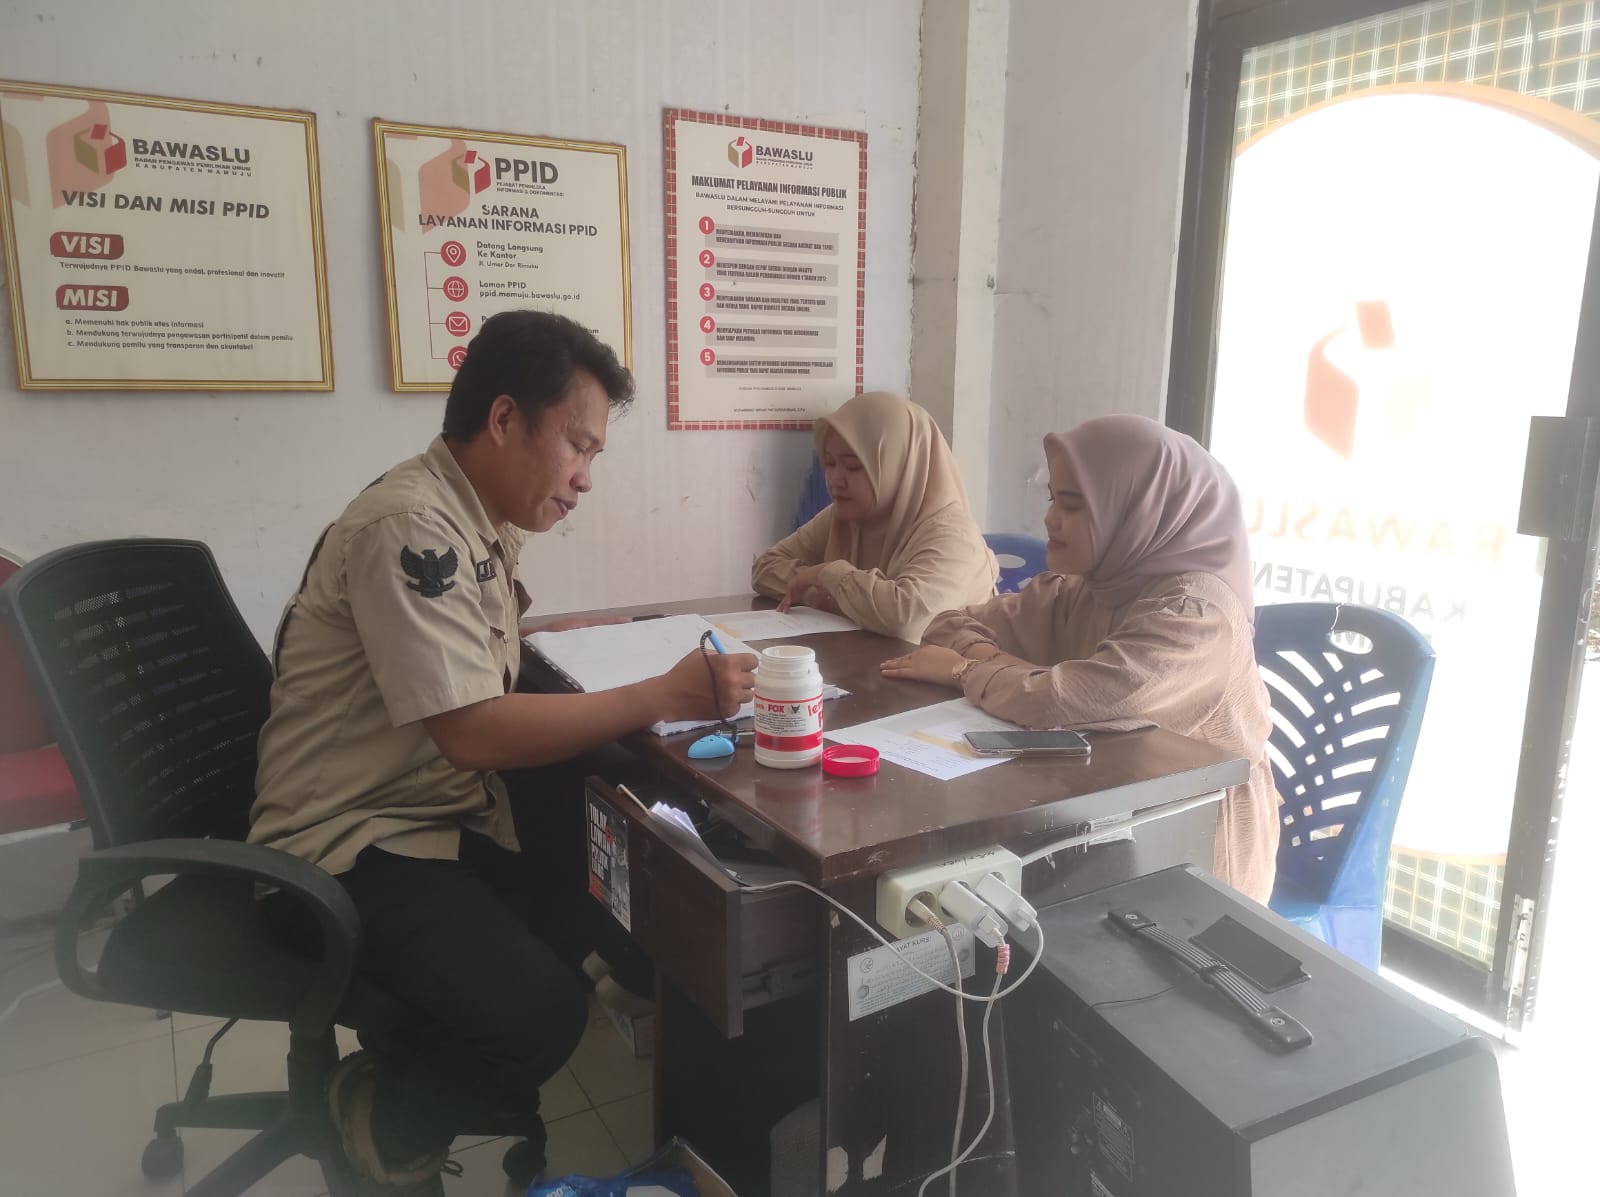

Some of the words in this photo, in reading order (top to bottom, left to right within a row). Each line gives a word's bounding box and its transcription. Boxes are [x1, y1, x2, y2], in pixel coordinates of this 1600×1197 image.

[132, 138, 251, 164] BAWASLU
[755, 145, 813, 162] BAWASLU
[135, 163, 203, 173] KABUPATEN
[158, 159, 195, 167] PENGAWAS
[494, 157, 559, 184] PPID
[691, 175, 735, 189] MAKLUMAT
[736, 180, 778, 193] PELAYANAN
[779, 183, 820, 197] INFORMASI
[821, 188, 847, 199] PUBLIK
[61, 190, 106, 208] VISI
[114, 194, 162, 212] DAN
[169, 198, 215, 216] MISI
[222, 201, 270, 219] PPID
[695, 191, 726, 200] BAWASLU
[749, 197, 778, 205] MELAYANI
[779, 200, 813, 208] PELAYANAN
[813, 203, 844, 211] INFORMASI
[481, 203, 540, 219] SARANA
[726, 204, 796, 215] BERSUNGGUH-SUNGGUH
[796, 209, 816, 217] UNTUK
[418, 214, 489, 230] LAYANAN
[491, 218, 566, 236] INFORMASI
[568, 222, 598, 237] PPID
[704, 220, 709, 230] 1
[60, 235, 111, 255] VISI
[476, 240, 506, 251] Datang
[507, 242, 544, 253] Langsung
[477, 250, 488, 258] Ke
[490, 250, 517, 259] Kantor
[703, 254, 711, 264] 2
[60, 262, 108, 271] Terwujudnya
[134, 265, 164, 273] Bawaslu
[165, 267, 183, 275] yang
[479, 280, 506, 288] Laman
[507, 281, 527, 289] PPID
[63, 288, 118, 307] MISI
[479, 290, 580, 301] ppid.mamuju.bawaslu.go.id
[703, 287, 711, 297] 3
[74, 318, 114, 326] Memenuhi
[115, 319, 130, 327] hak
[131, 319, 153, 329] publik
[171, 320, 204, 329] informasi
[703, 319, 711, 330] 4
[66, 329, 74, 337] b.
[75, 329, 120, 339] Mendukung
[121, 330, 166, 340] terwujudnya
[76, 340, 120, 350] Mendukung
[122, 341, 146, 350] pemilu
[147, 343, 165, 351] yang
[704, 352, 711, 362] 5
[767, 704, 785, 713] FOX
